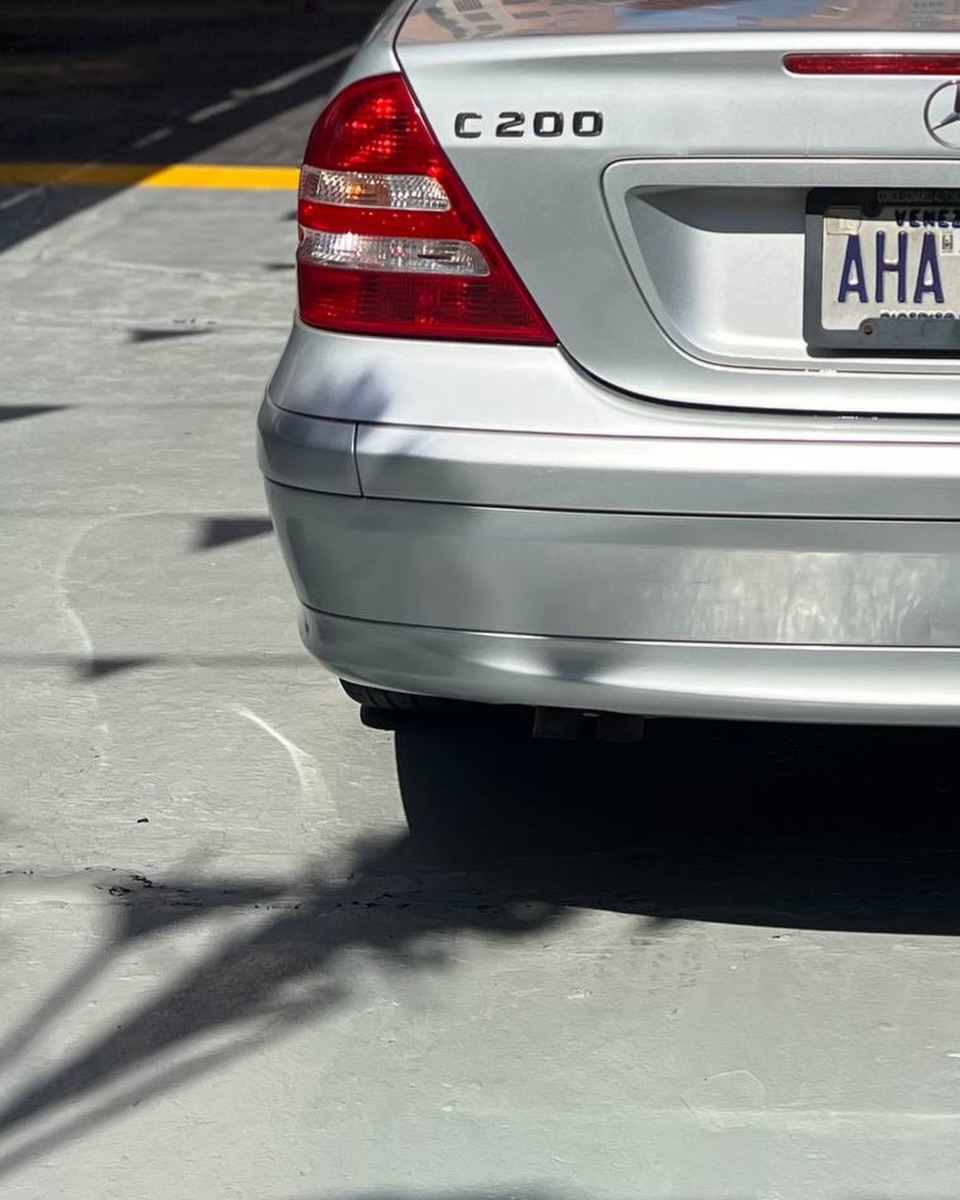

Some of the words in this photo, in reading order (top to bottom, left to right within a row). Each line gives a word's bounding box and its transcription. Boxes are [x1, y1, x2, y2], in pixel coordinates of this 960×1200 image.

[454, 112, 483, 139] C
[495, 111, 604, 138] 200
[837, 230, 945, 304] AHA
